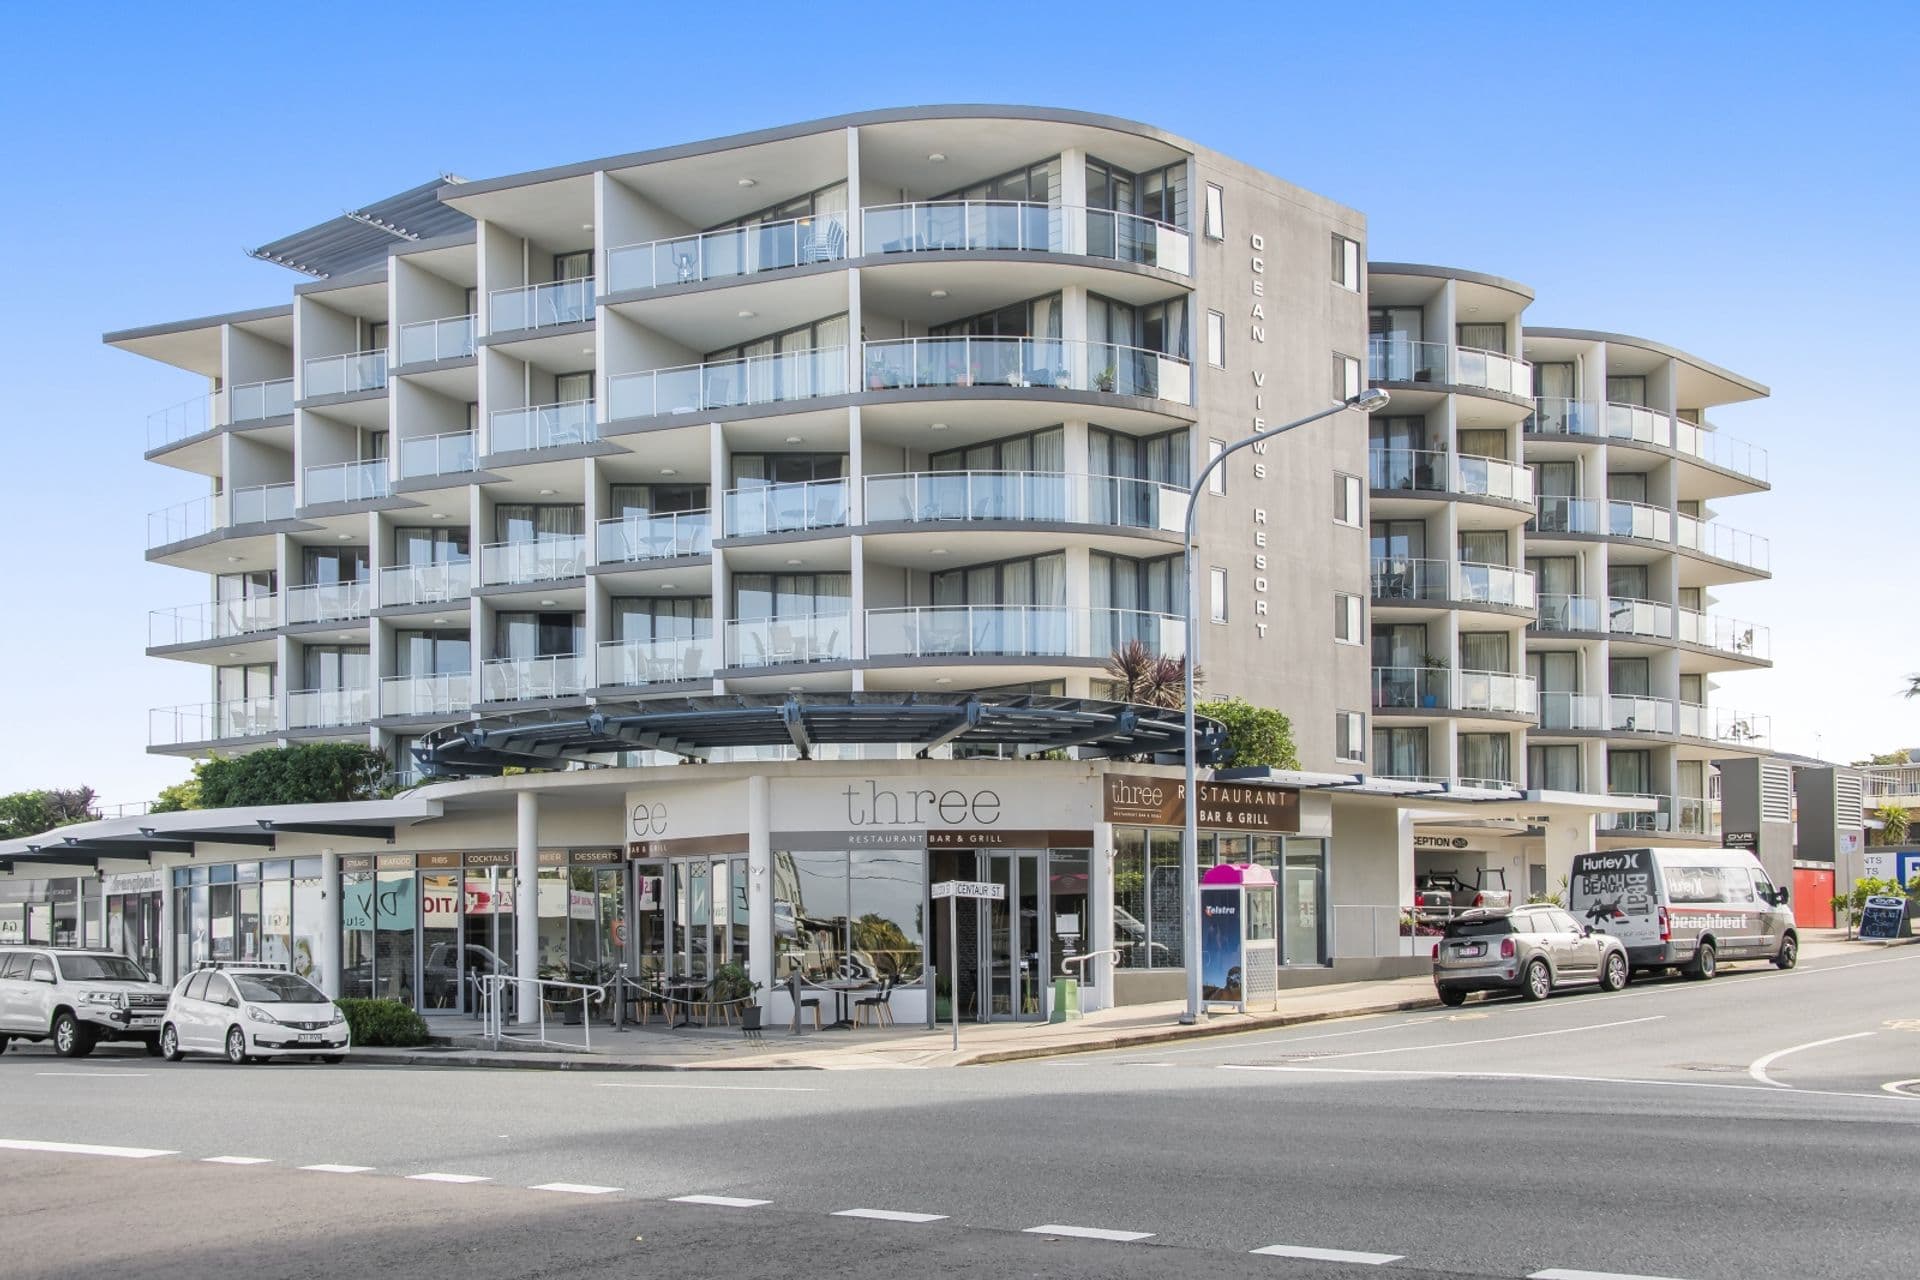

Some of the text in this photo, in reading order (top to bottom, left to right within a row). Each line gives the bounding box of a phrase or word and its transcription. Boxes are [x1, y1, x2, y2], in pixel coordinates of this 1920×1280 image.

[1250, 233, 1268, 639] OCEAN VIEWS RESORT
[1111, 780, 1163, 806] three
[1178, 785, 1287, 806] RSTAURANT
[842, 780, 1001, 826] three
[1200, 810, 1269, 825] BAR & GRILL
[848, 834, 1003, 844] RESTAURANT BAR & GRILL
[431, 856, 449, 864] RIBS
[468, 854, 510, 863] COCKTAILS
[539, 852, 563, 861] BEER
[574, 852, 618, 861] DESSERTS
[1583, 856, 1624, 871] Hurley
[957, 884, 988, 896] CENTAUR
[991, 886, 1001, 897] ST
[1583, 873, 1625, 895] BEACH
[1205, 905, 1236, 915] Telstra
[1670, 912, 1748, 929] beachbeat
